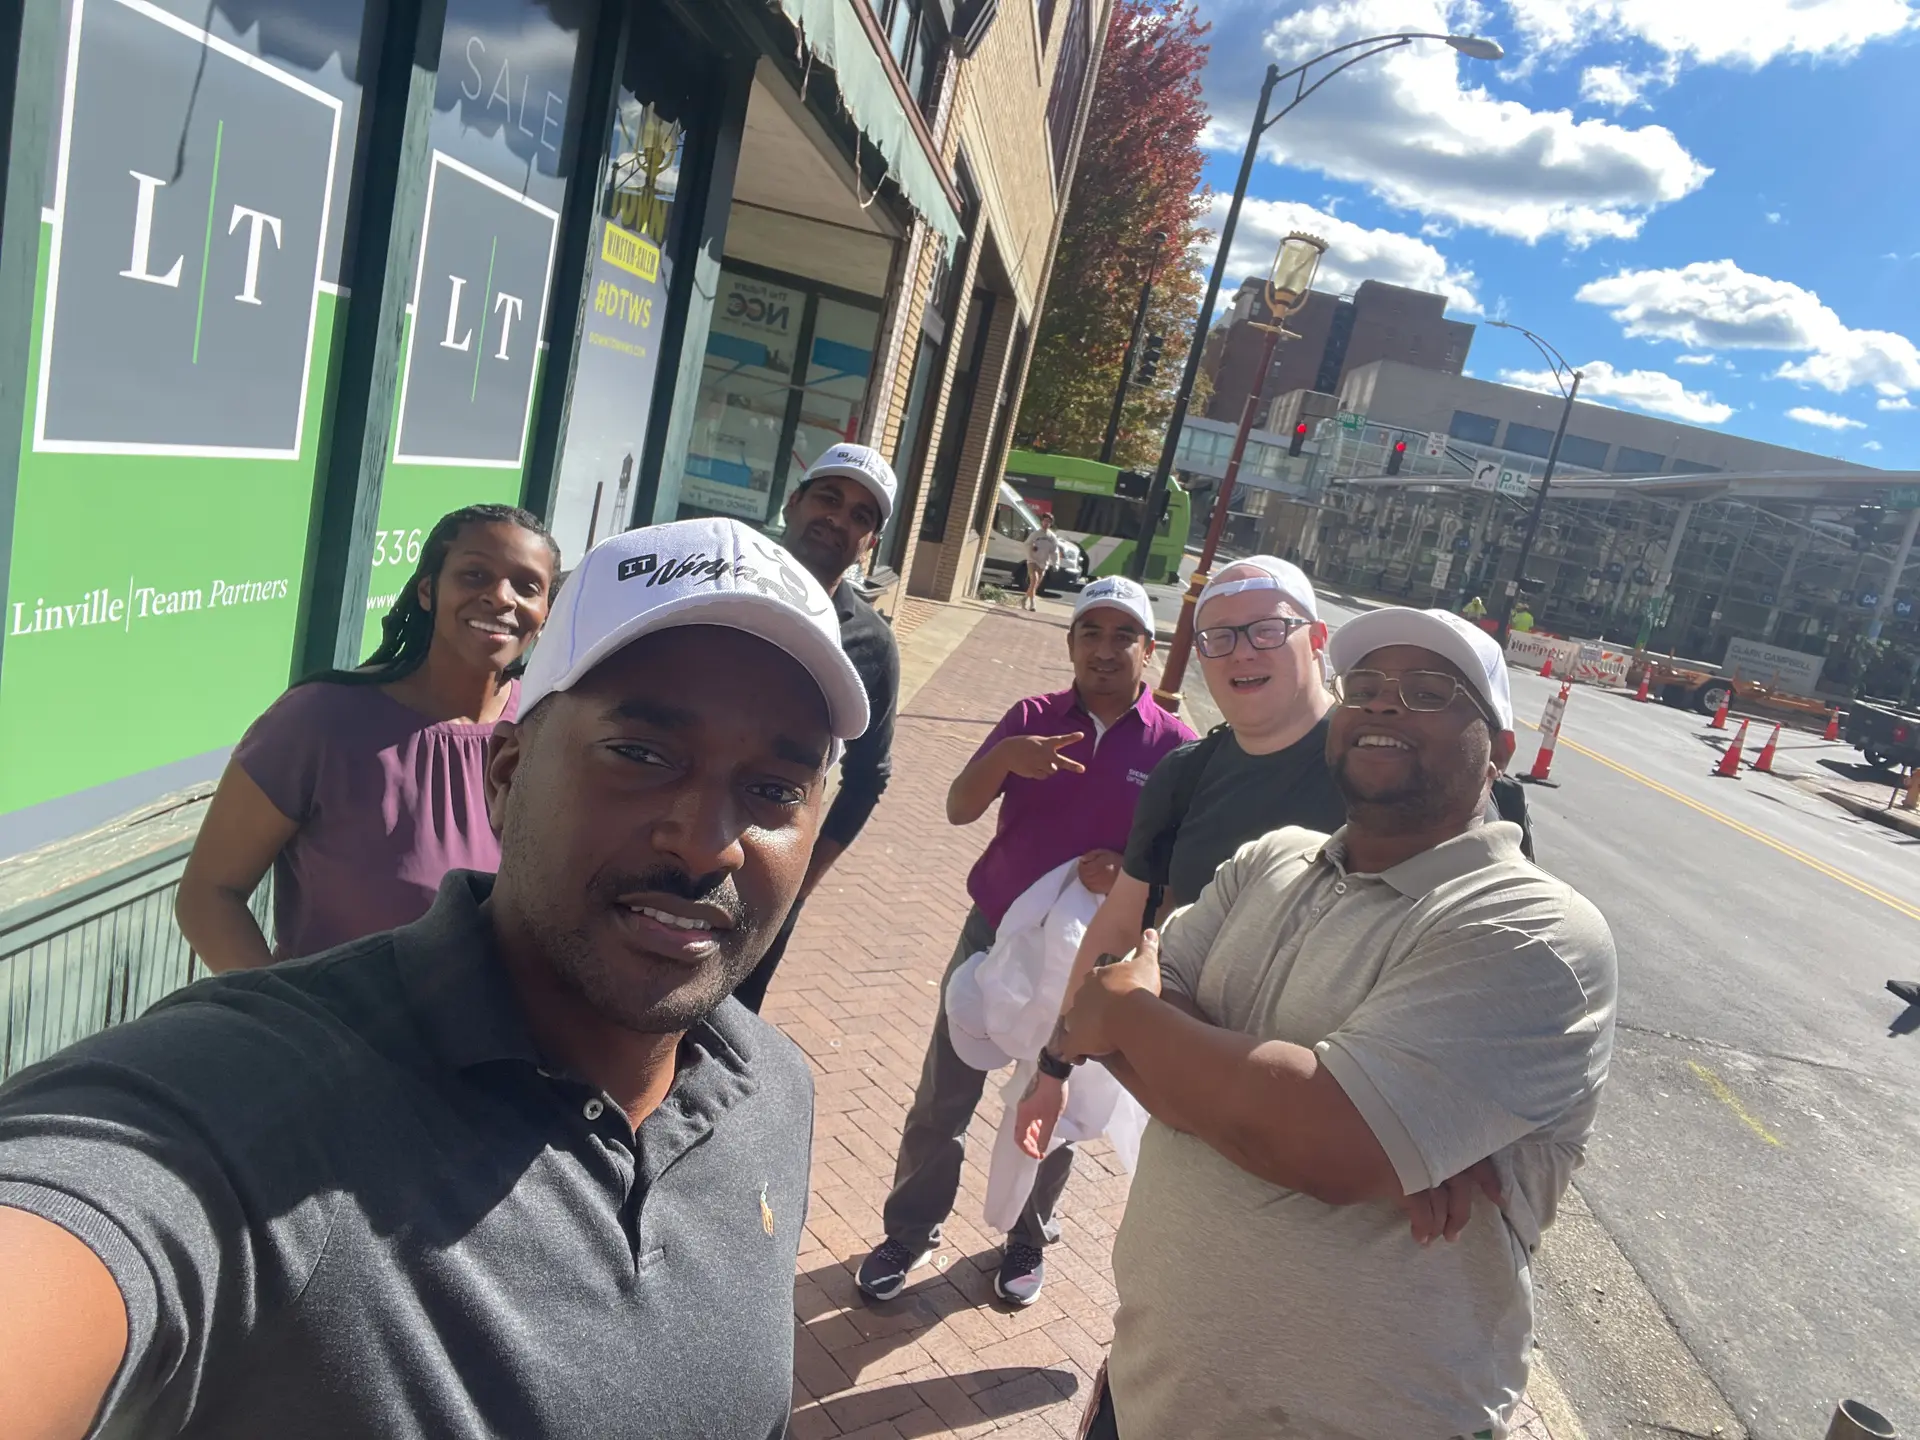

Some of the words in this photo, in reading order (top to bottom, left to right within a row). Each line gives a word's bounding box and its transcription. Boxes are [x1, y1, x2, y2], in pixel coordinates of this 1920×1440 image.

[461, 36, 563, 152] SALE
[607, 229, 657, 278] WINSTON-SALEM
[594, 279, 652, 329] #DTWS
[372, 527, 422, 567] 336
[624, 559, 651, 576] IT
[10, 588, 124, 636] Linville
[135, 587, 202, 618] Team
[207, 578, 288, 608] Partners
[1732, 645, 1761, 657] CLARK
